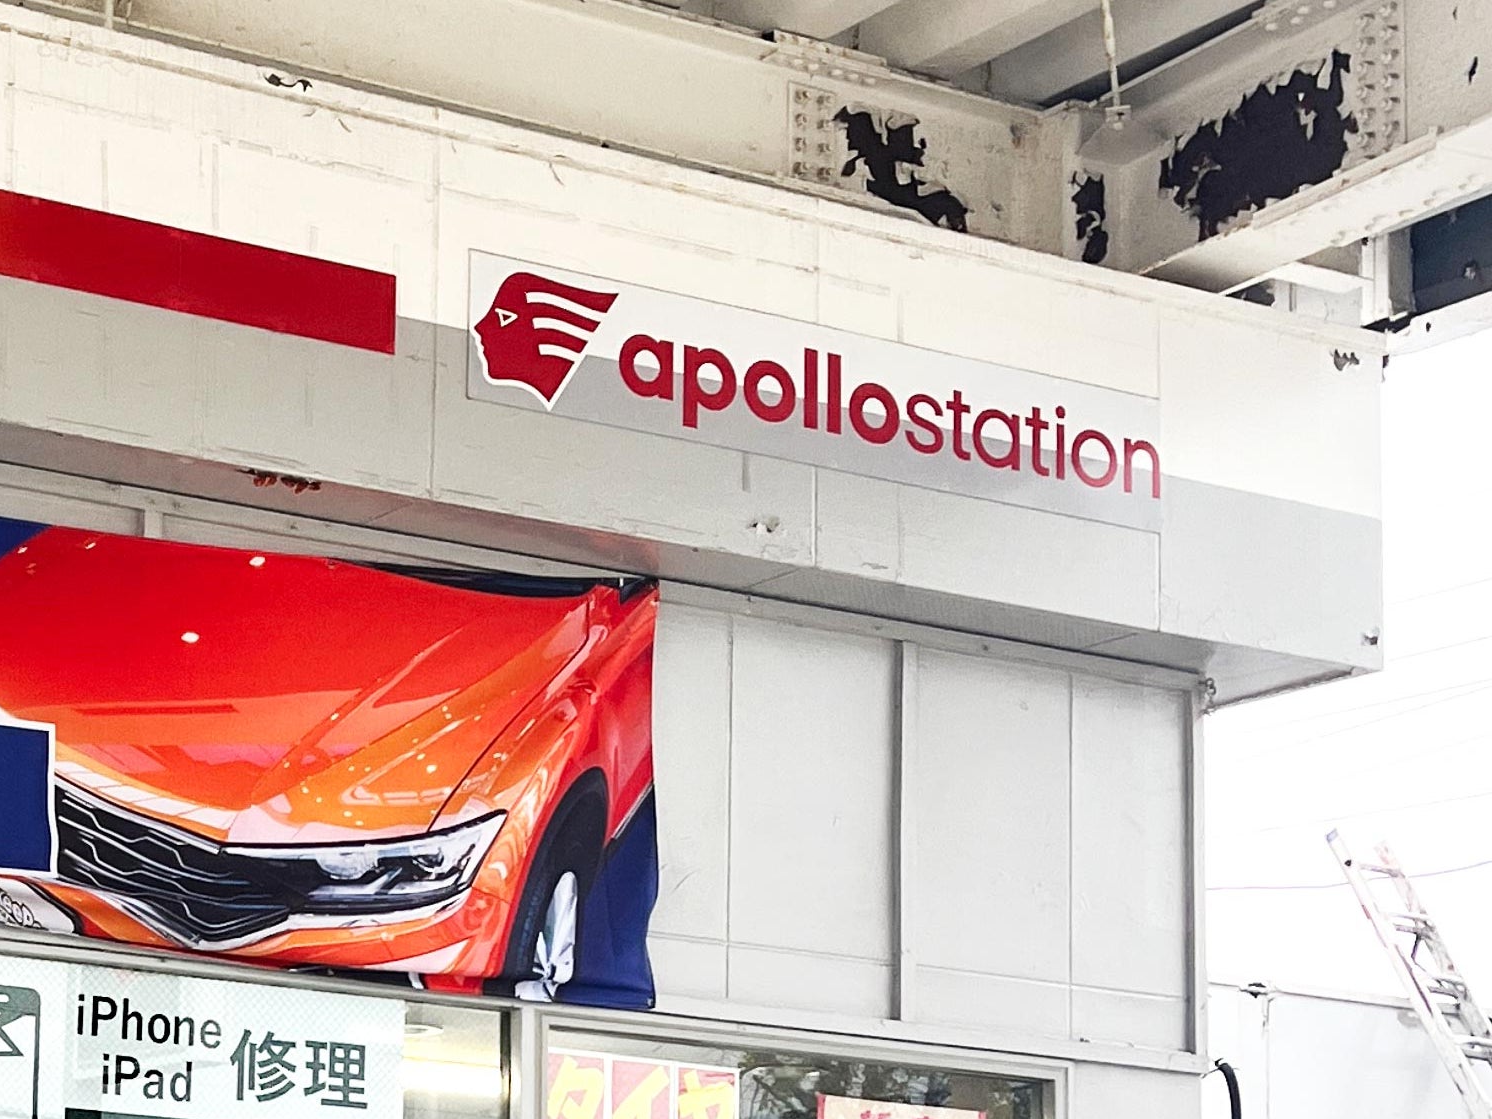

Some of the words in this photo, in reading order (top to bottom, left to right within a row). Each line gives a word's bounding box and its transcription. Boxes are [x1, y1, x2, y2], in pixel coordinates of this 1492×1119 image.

[618, 334, 1161, 498] apollostation
[76, 992, 223, 1050] iPhone
[101, 1052, 194, 1102] iPad
[229, 1029, 369, 1110] 修理
